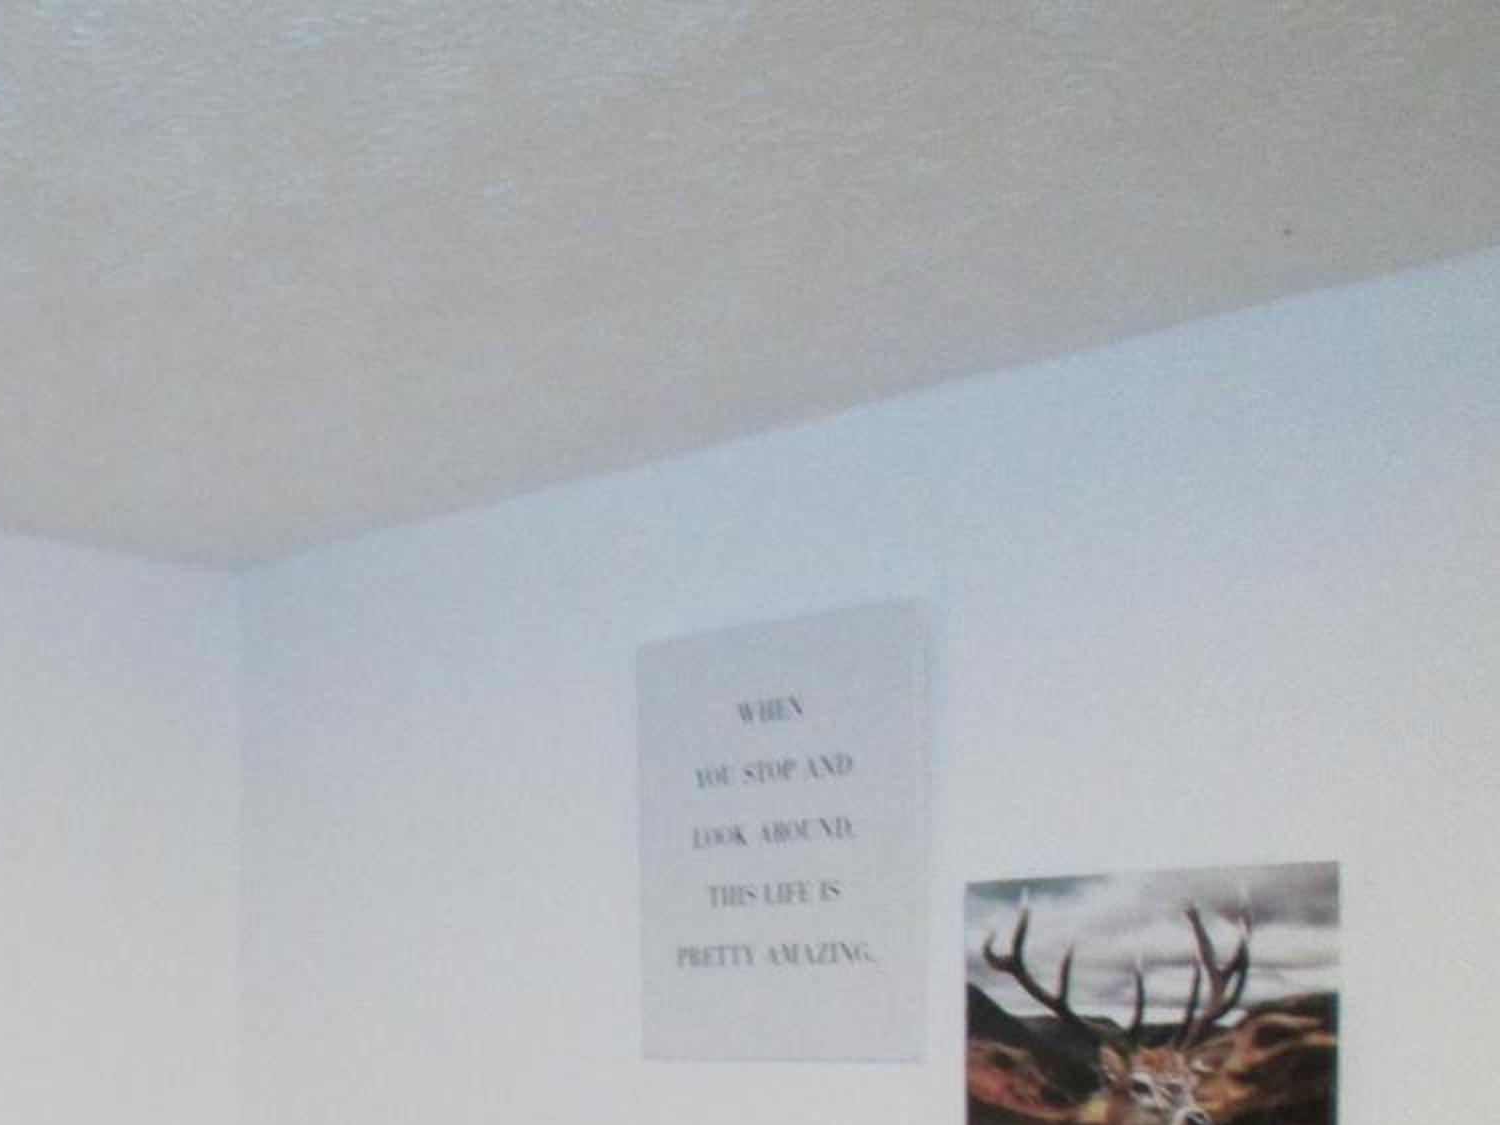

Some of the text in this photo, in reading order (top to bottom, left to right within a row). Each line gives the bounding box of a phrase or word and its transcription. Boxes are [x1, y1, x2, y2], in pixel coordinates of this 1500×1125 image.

[737, 696, 803, 722] WHEN
[694, 751, 853, 789] YOU STOP AND
[691, 825, 748, 850] LOOK
[709, 878, 841, 909] THIS LIFE IS
[676, 944, 756, 968] PRETTY
